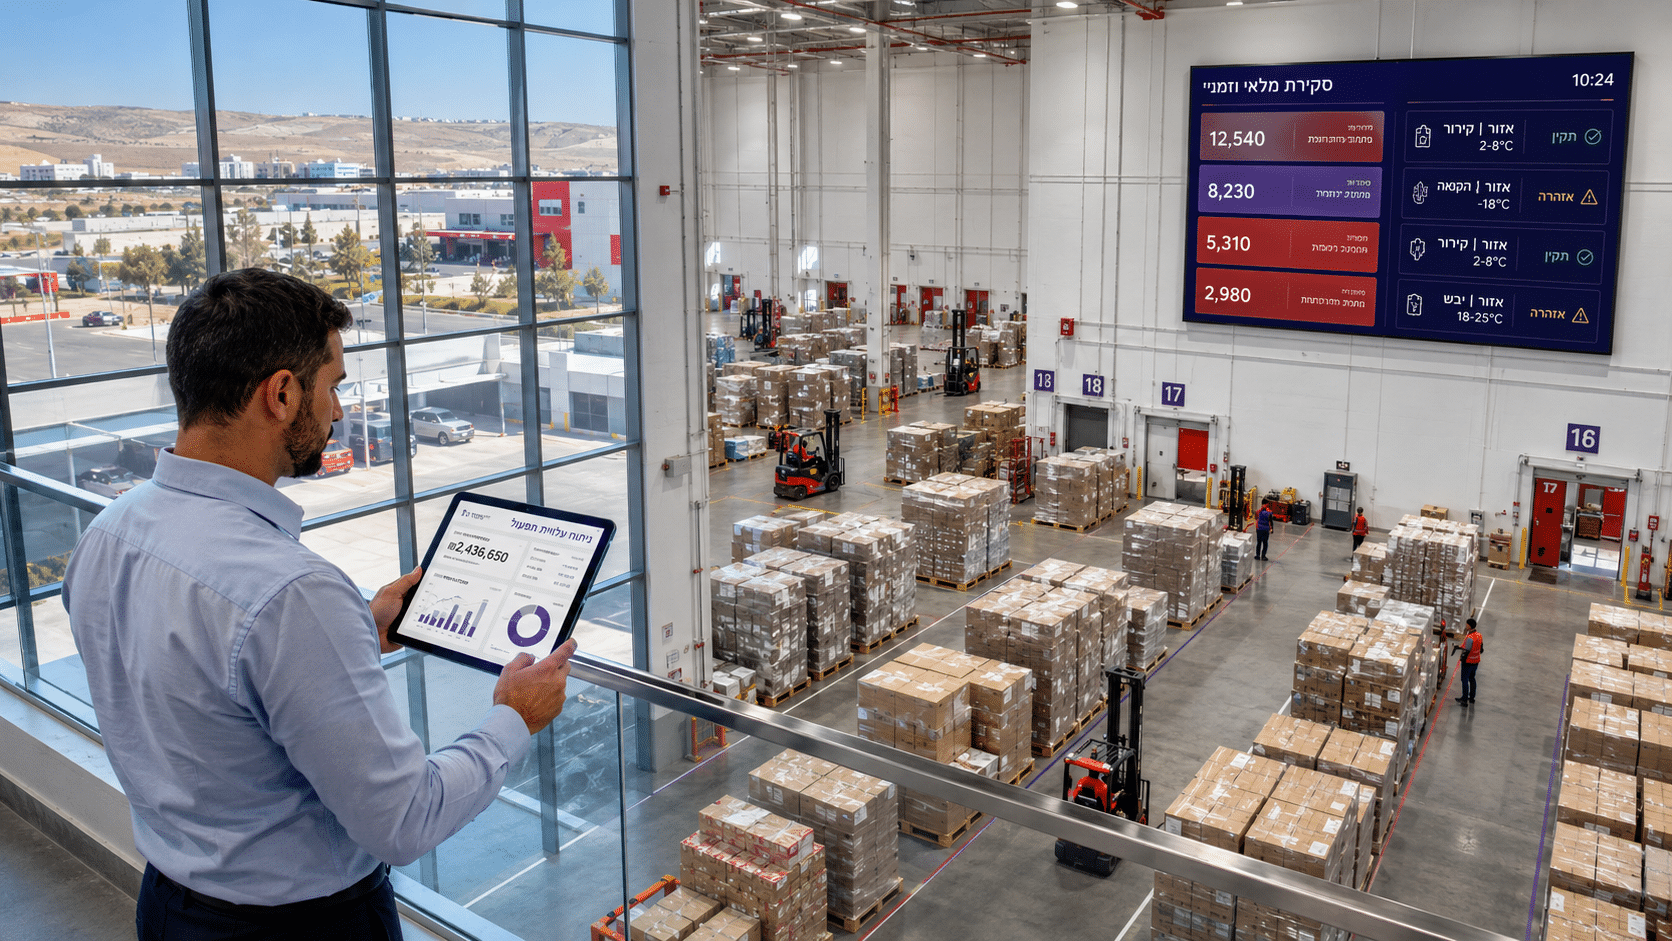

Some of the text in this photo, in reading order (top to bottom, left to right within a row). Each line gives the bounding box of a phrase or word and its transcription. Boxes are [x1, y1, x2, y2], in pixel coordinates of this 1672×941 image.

[1243, 77, 1279, 93] מלאי
[1572, 72, 1615, 87] 10:24
[1283, 78, 1333, 95] סקירת
[1443, 124, 1475, 137] קירור
[1487, 124, 1514, 134] אזור
[1209, 131, 1266, 149] 12,540
[1551, 132, 1577, 144] תקין
[1479, 140, 1514, 151] 2-8°C
[1207, 182, 1255, 202] 8,230
[1484, 182, 1511, 193] אזור
[1538, 192, 1575, 202] אזהרה
[1477, 198, 1510, 210] -18°C
[1206, 234, 1251, 253] 5,310
[1437, 238, 1469, 252] קירור
[1481, 240, 1508, 251] אזור
[1473, 255, 1507, 268] 2-8°C
[1544, 251, 1570, 263] תקין
[1204, 285, 1251, 304] 2,980
[1443, 294, 1466, 305] יבש
[1478, 296, 1504, 308] אזור
[1457, 311, 1503, 324] 18-25°C
[1530, 308, 1566, 319] אזהרה
[1037, 372, 1052, 388] 18
[1085, 377, 1102, 394] 18
[1165, 385, 1183, 403] 17
[1571, 427, 1596, 449] 16
